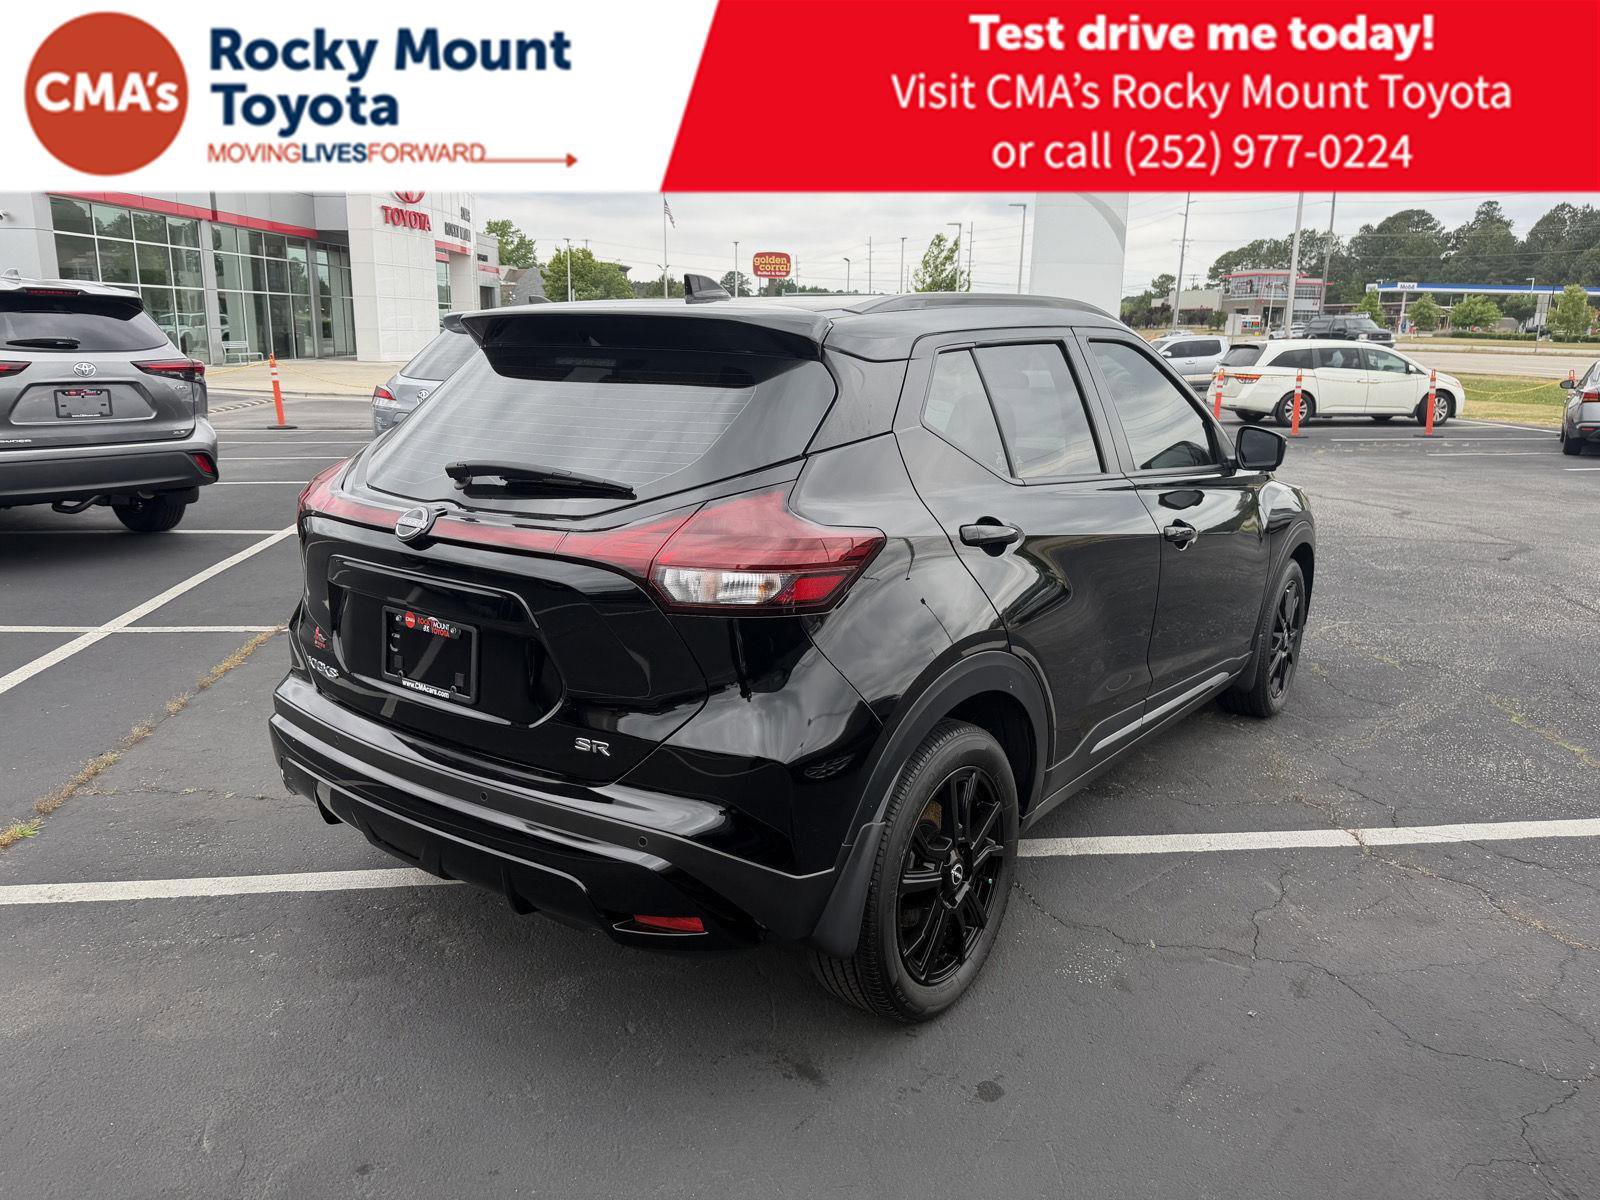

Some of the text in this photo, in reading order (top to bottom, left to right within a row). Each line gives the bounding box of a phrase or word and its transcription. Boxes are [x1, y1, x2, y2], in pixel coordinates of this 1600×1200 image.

[381, 205, 432, 232] TOYOTA
[754, 256, 787, 265] golden
[759, 263, 790, 271] corral
[401, 679, 450, 699] www.CMAcars.com
[574, 737, 611, 757] SR
